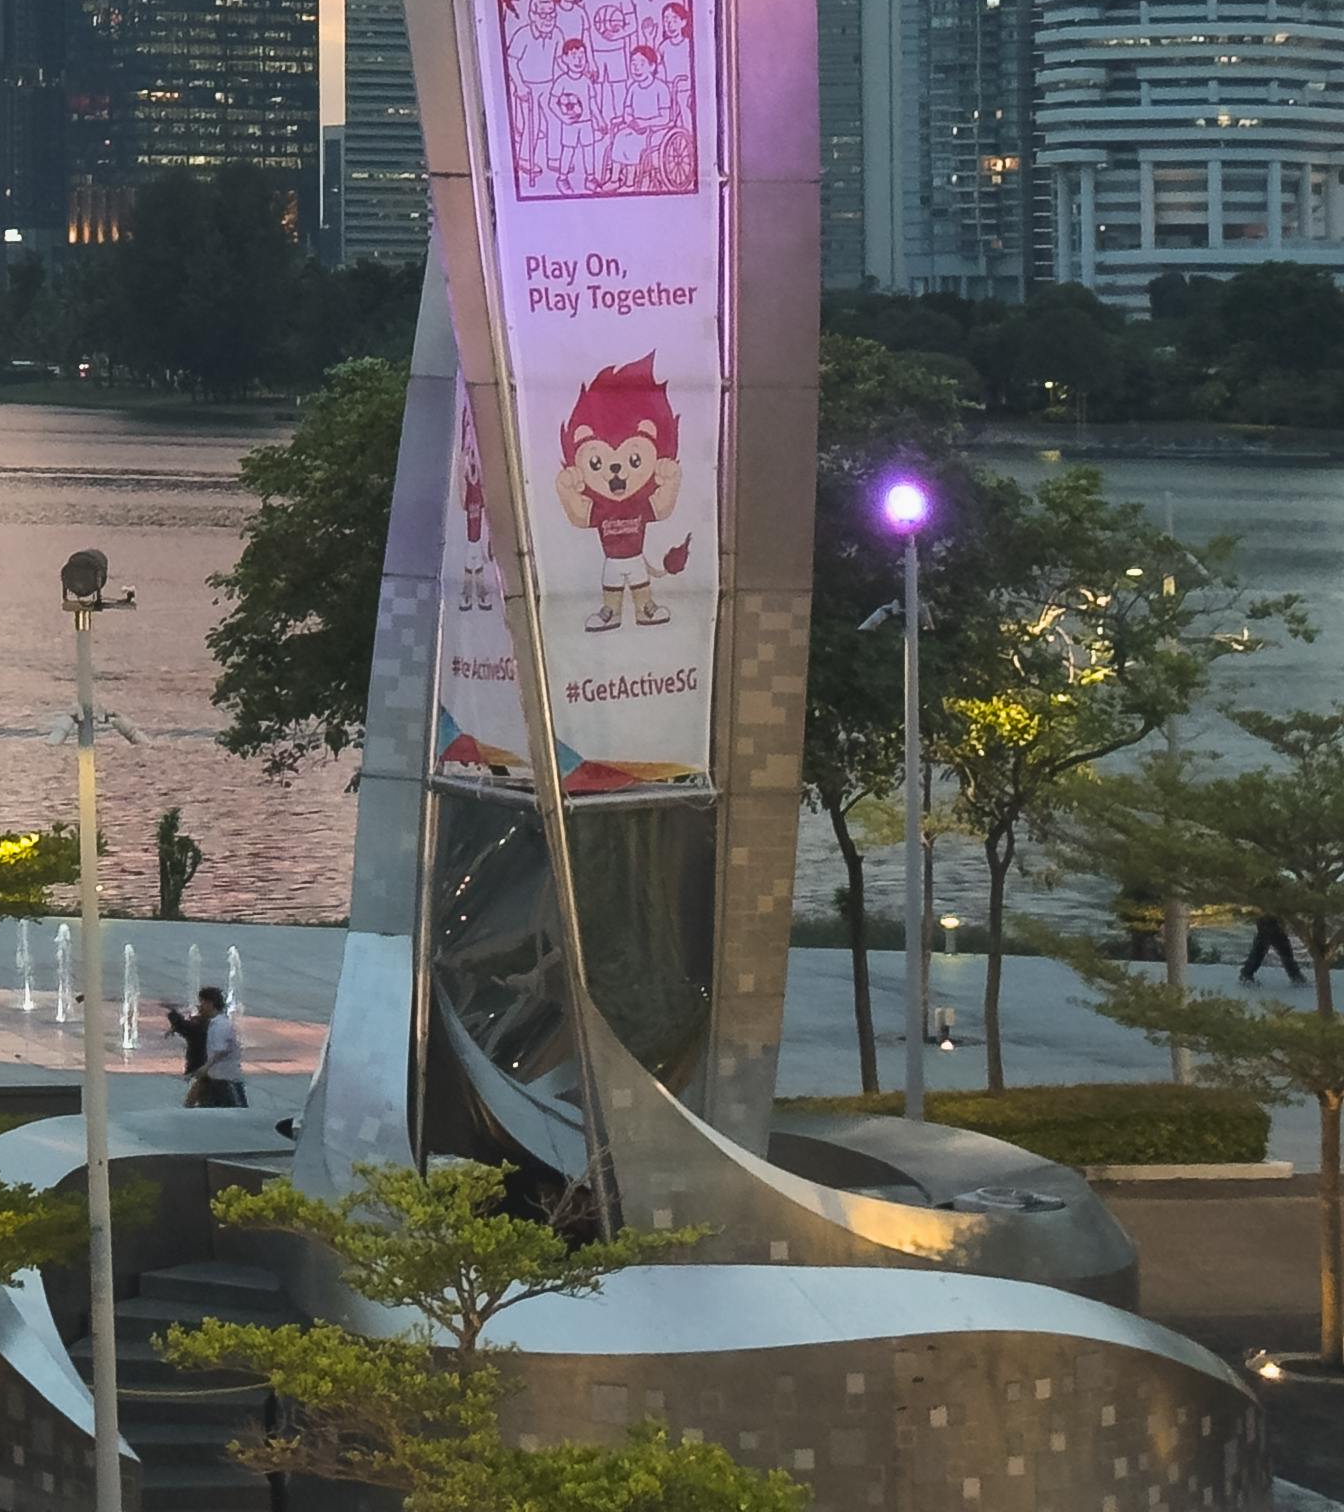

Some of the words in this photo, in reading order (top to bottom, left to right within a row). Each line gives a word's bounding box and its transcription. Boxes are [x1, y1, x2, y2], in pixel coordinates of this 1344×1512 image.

[526, 254, 578, 286] Play
[586, 253, 628, 279] On,
[529, 287, 580, 318] Play
[587, 282, 698, 316] Together
[566, 667, 698, 704] #GetActiveSG
